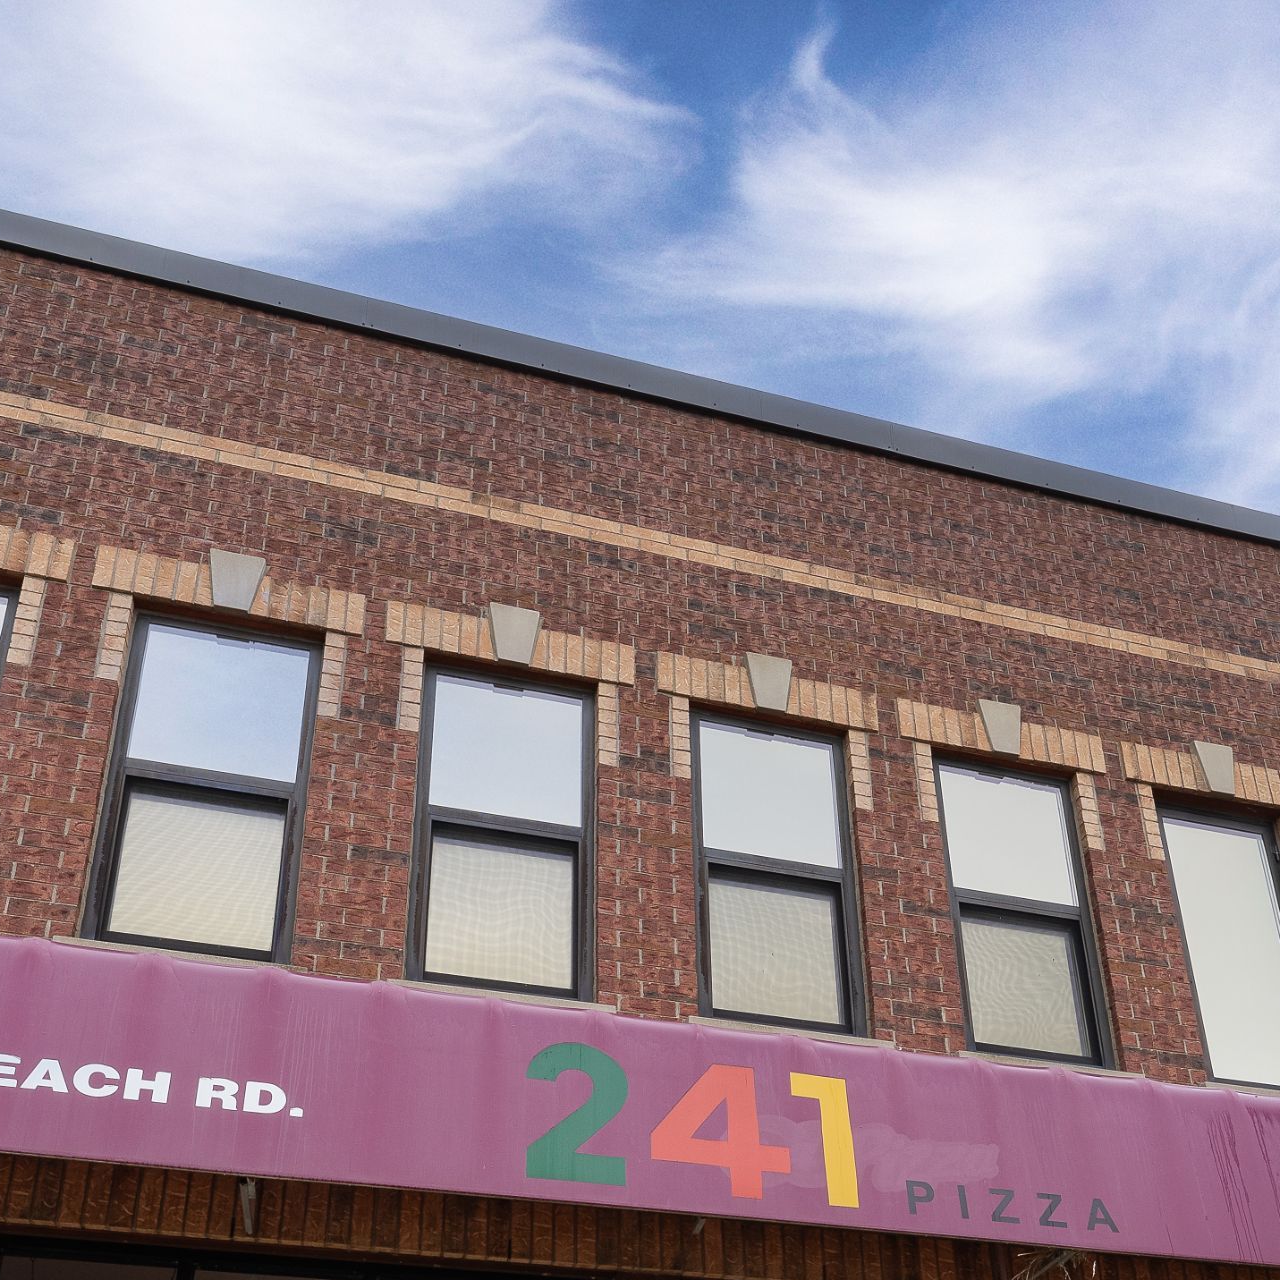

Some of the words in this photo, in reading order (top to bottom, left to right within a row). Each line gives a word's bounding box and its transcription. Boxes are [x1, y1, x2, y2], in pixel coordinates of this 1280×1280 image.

[195, 1077, 302, 1118] RD.
[525, 1041, 859, 1208] 241
[909, 1179, 1119, 1233] PIZZA
